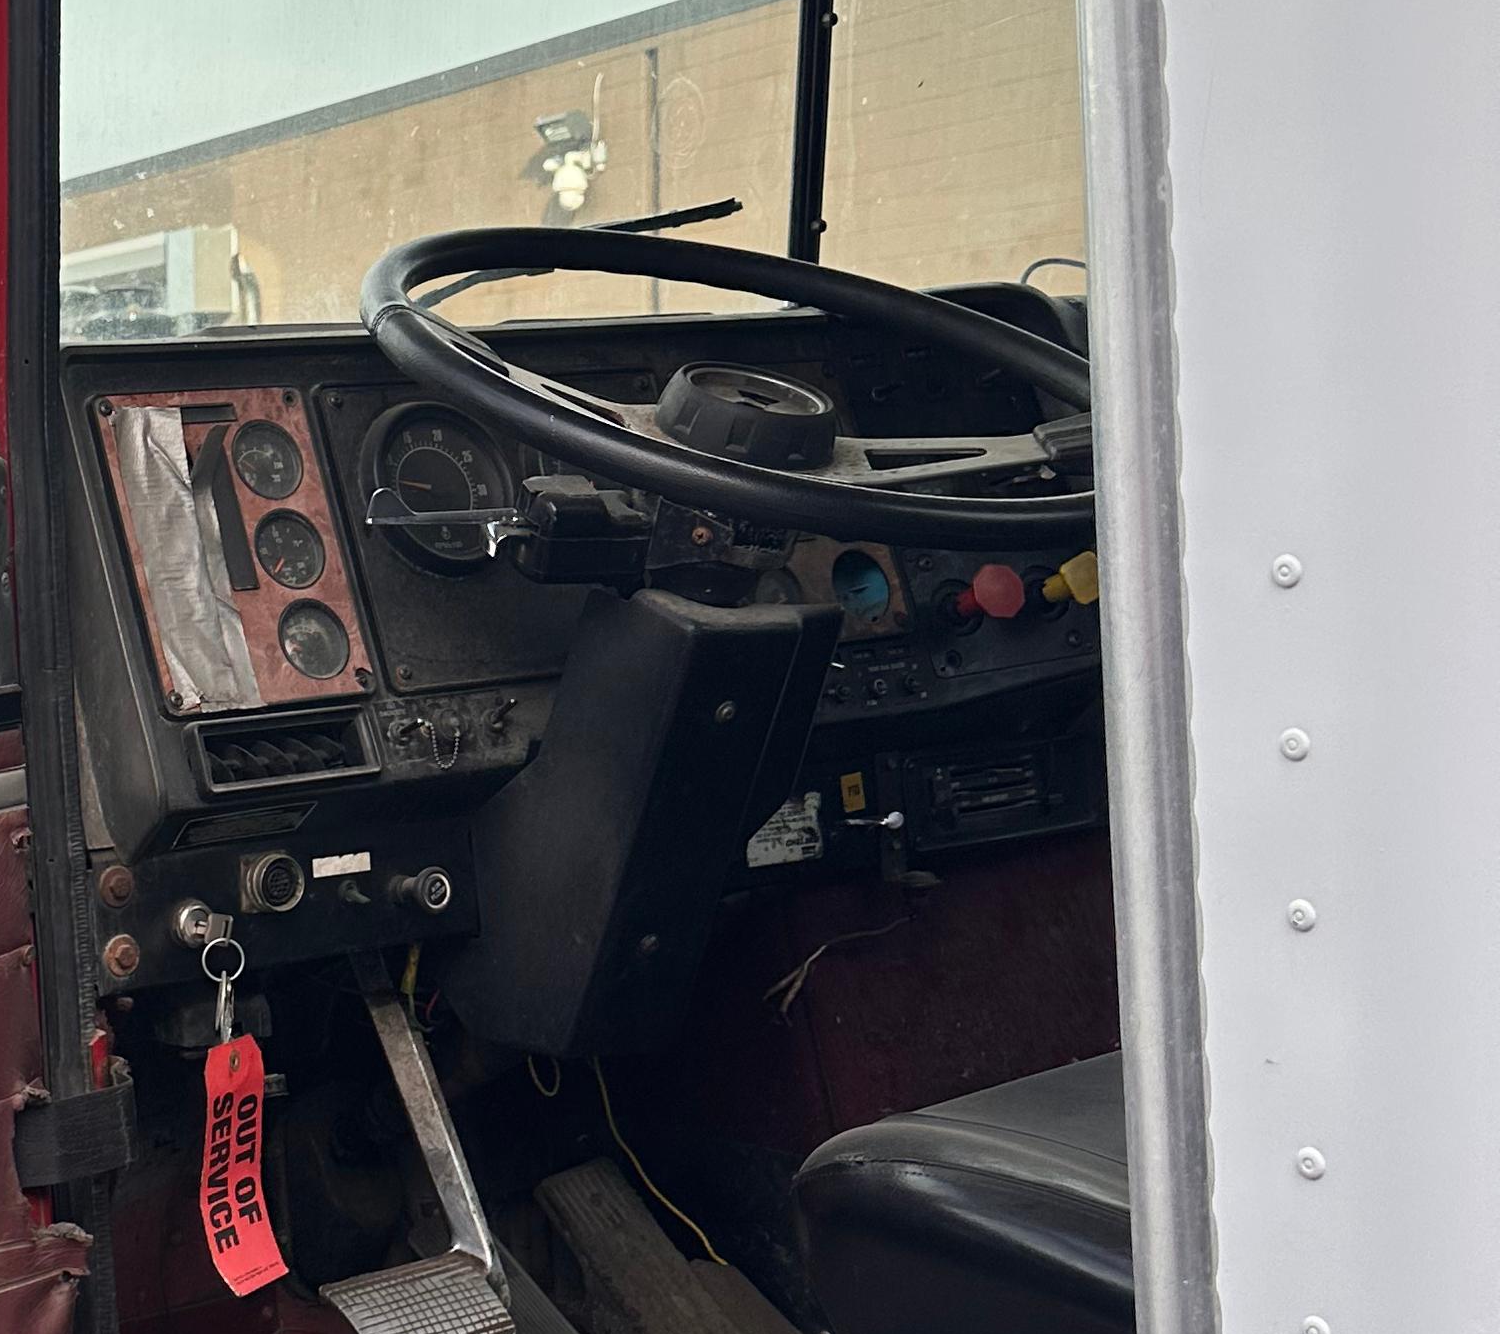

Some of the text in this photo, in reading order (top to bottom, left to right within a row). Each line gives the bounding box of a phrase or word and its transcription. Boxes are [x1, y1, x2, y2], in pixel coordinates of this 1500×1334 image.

[207, 1091, 240, 1255] SERVICE
[234, 1093, 263, 1225] OUT OF
